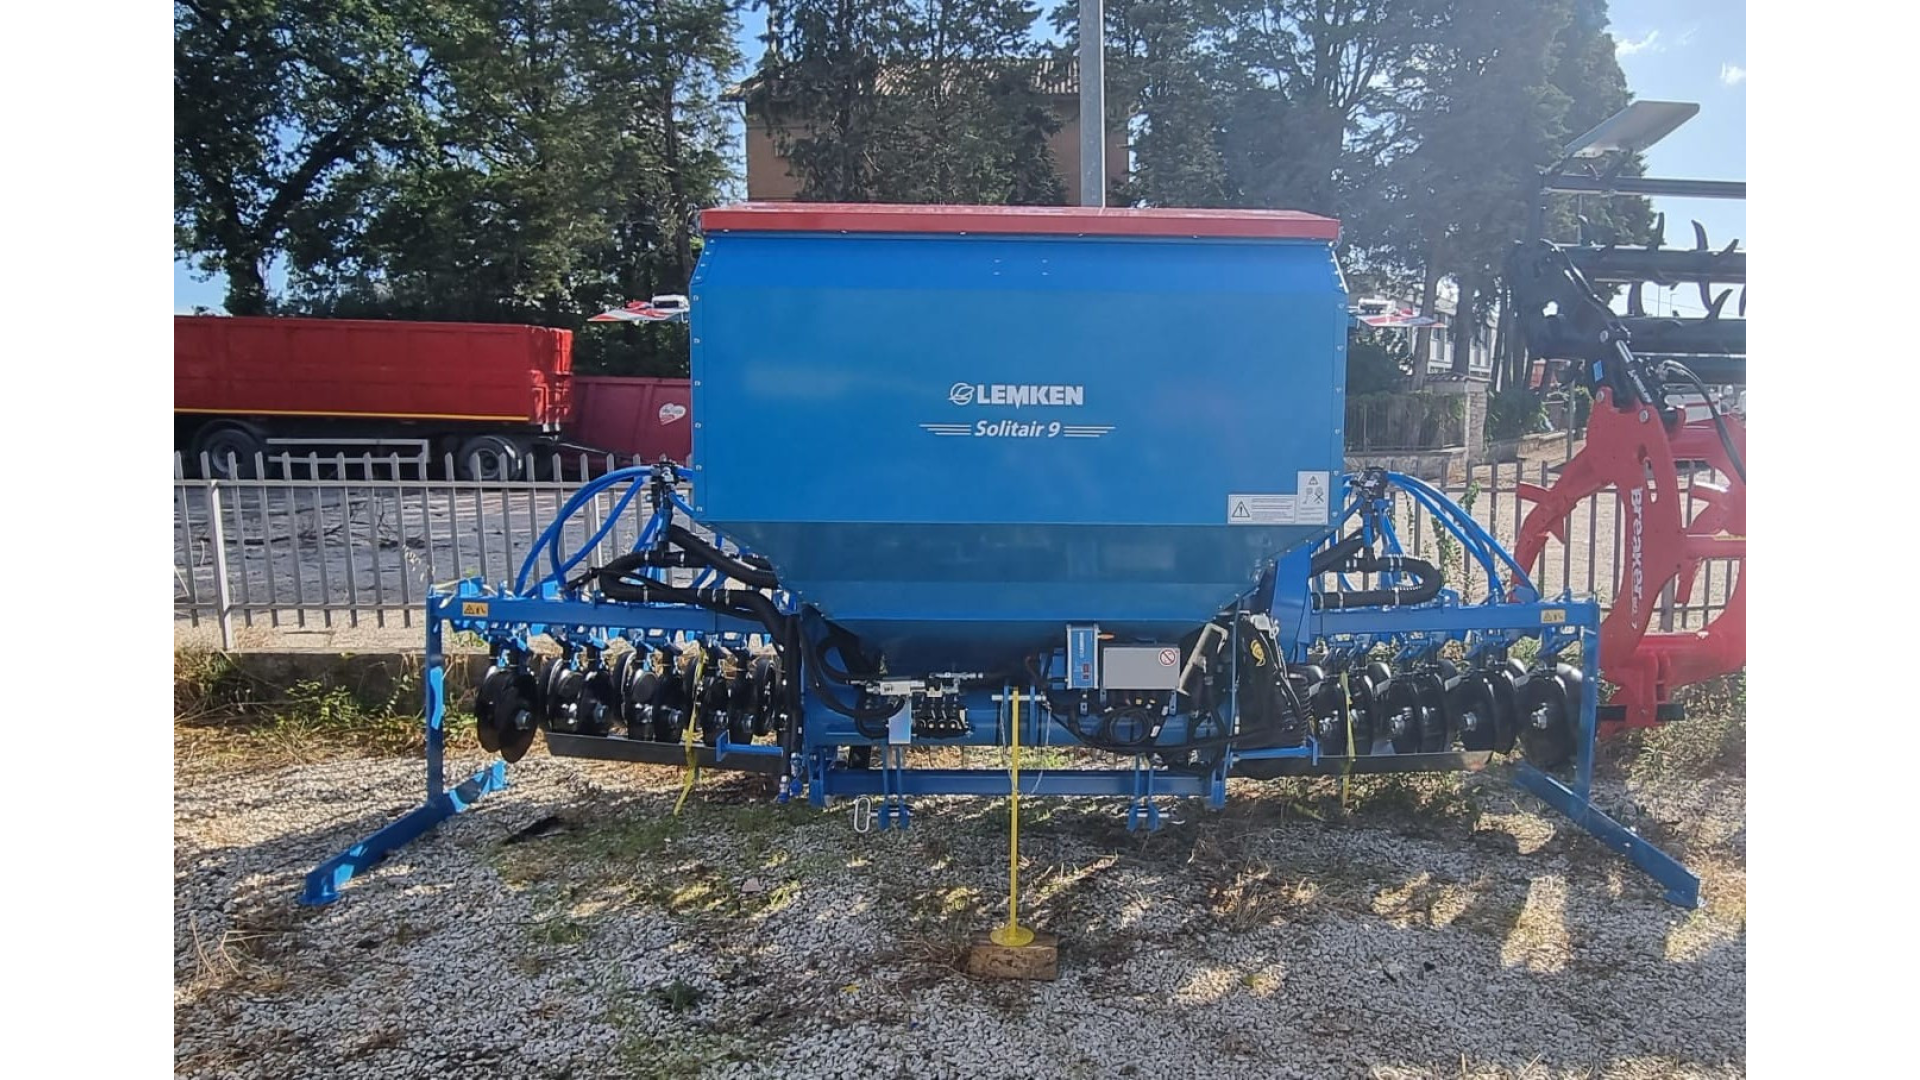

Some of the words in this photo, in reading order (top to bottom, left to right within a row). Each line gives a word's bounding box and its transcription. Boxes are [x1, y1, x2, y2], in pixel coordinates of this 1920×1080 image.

[977, 384, 1084, 409] LEMKEN
[974, 420, 1044, 438] Solitair
[1048, 421, 1061, 438] 9
[1631, 486, 1643, 600] Breaker
